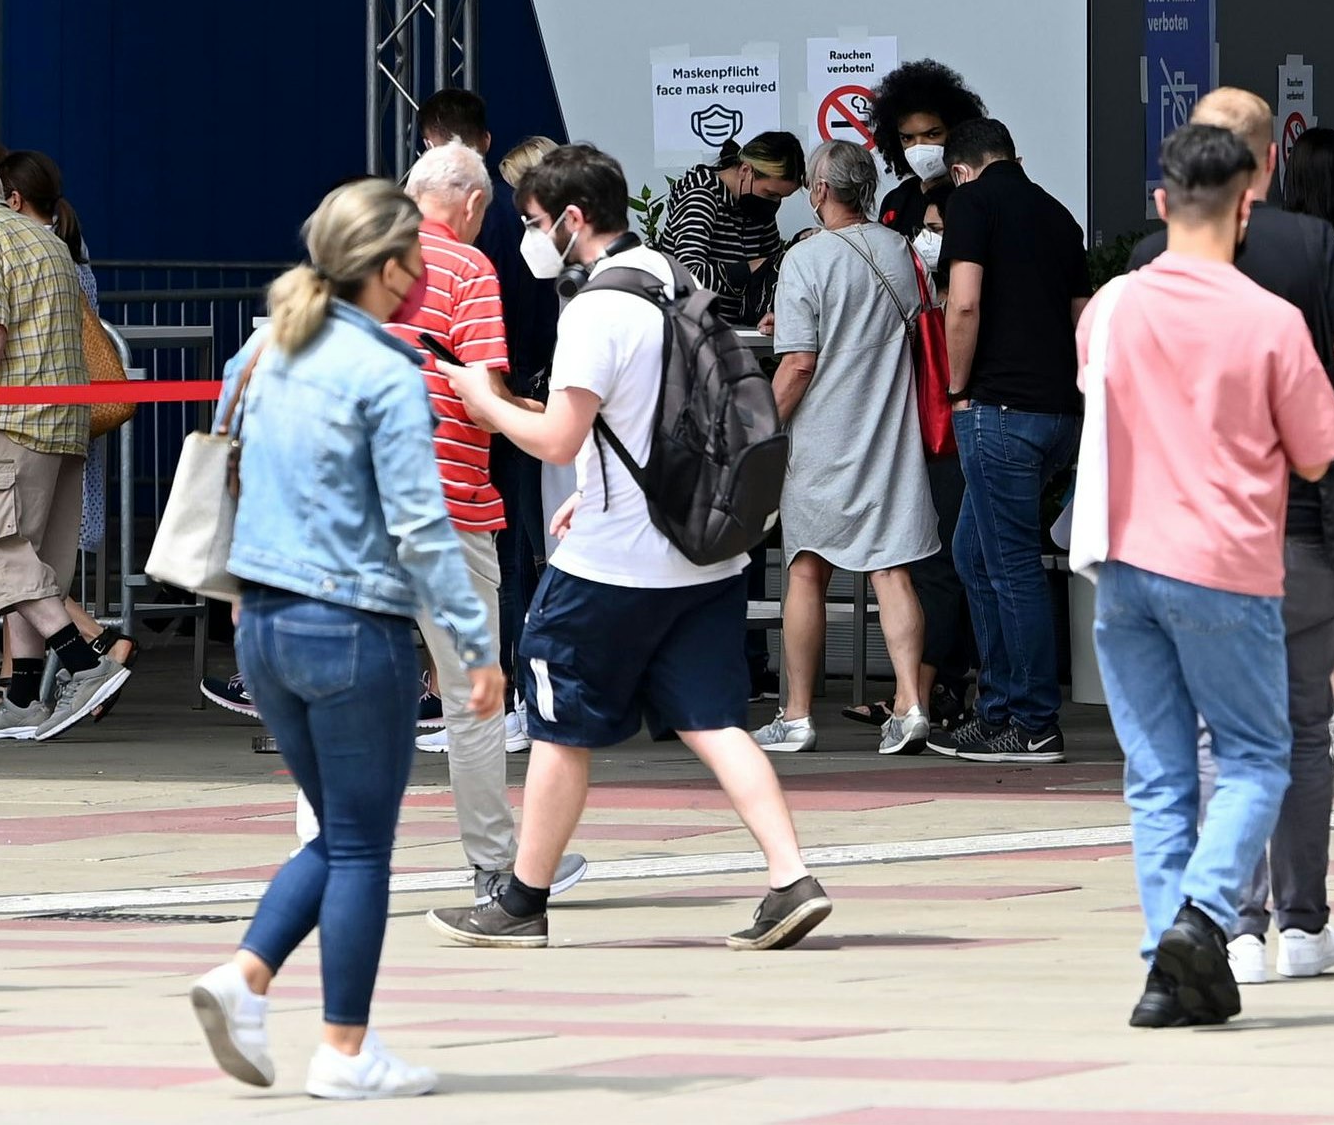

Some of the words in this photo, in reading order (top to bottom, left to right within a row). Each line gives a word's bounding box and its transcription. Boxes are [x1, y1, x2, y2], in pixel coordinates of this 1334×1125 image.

[1147, 11, 1189, 32] verboten
[829, 50, 872, 61] Rauchen
[672, 65, 760, 80] Maskenpflicht
[827, 62, 875, 74] verboten!
[656, 84, 683, 96] face
[686, 83, 719, 95] mask
[723, 81, 777, 95] required
